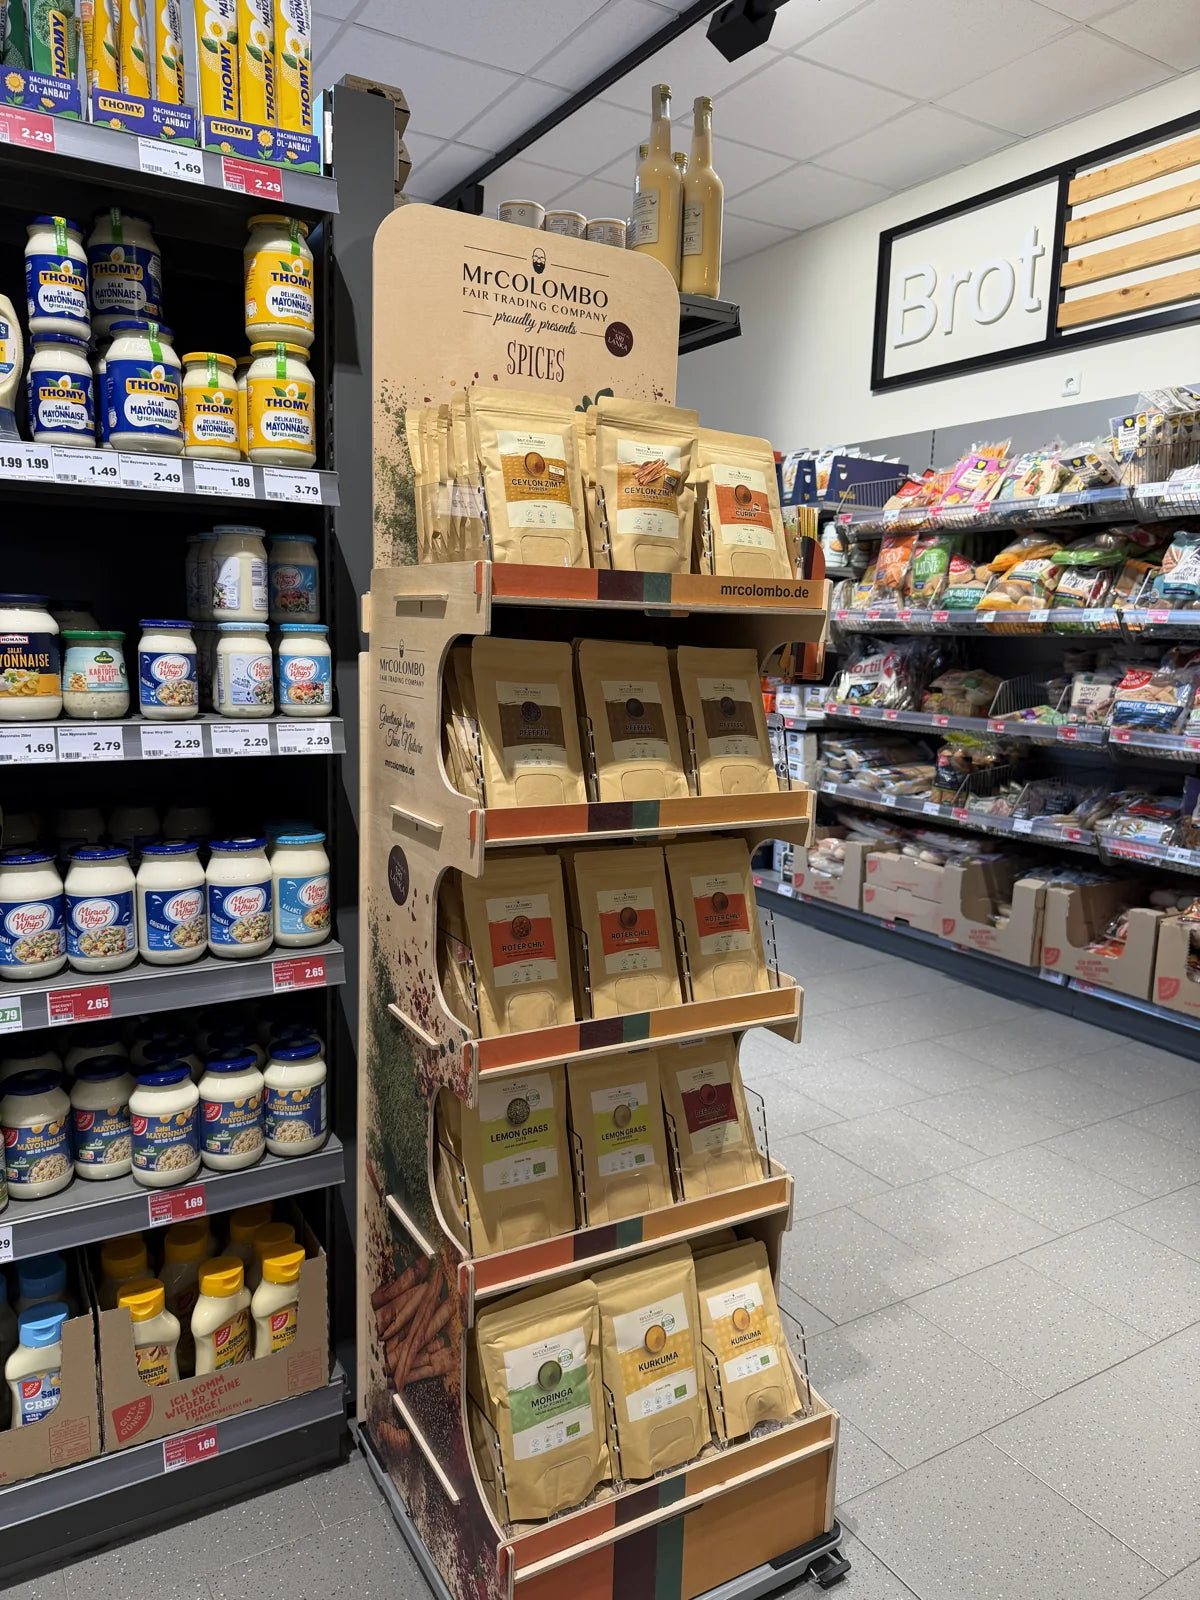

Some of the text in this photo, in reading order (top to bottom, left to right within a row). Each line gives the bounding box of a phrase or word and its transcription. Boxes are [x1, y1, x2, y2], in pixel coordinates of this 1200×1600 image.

[53, 14, 66, 77] HOMY
[29, 76, 71, 90] NACHHALTIGER
[176, 60, 184, 105] HOMY
[221, 43, 233, 112] THOMY
[264, 52, 275, 121] THOMY
[299, 59, 311, 127] THOMY
[101, 98, 142, 114] THOMY
[152, 107, 191, 120] NACHHALTIGER
[22, 127, 52, 142] 2.29
[213, 123, 251, 137] THOMY
[277, 132, 312, 144] NACHHALTIGER
[174, 161, 201, 174] 1.69
[255, 179, 281, 192] 2.29
[93, 263, 140, 276] THOMY
[41, 272, 84, 287] THOMY
[270, 272, 312, 289] THOMY
[463, 263, 608, 308] MrCOLOMBO
[893, 225, 1046, 349] Brot
[95, 289, 141, 300] MAYONNAISE
[43, 294, 85, 309] MAYONNAISE
[272, 296, 312, 313] MAYONNAISE
[463, 287, 608, 322] FAIR TRADING COMPANY
[493, 312, 577, 335] proudly presents
[507, 340, 565, 382] SPICES
[128, 380, 177, 394] THOMY
[40, 388, 84, 400] THOMY
[196, 404, 234, 414] THOMY
[265, 398, 309, 411] THOMY
[42, 409, 85, 421] MAYONNAISE
[130, 405, 178, 420] MAYONNAISE
[274, 416, 303, 424] DELIKATESS
[197, 424, 234, 435] MAYONNAISE
[266, 422, 310, 435] MAYONNAISE
[0, 457, 49, 469] 1.99 1.99
[89, 466, 117, 476] 1.49
[154, 472, 180, 482] 2.49
[231, 477, 250, 487] 1.89
[512, 478, 543, 486] CEYLON
[295, 485, 318, 495] 3.79
[625, 487, 656, 495] CEYLON
[720, 584, 809, 598] mrcolombo.de
[0, 653, 49, 667] YONNAISE
[158, 661, 186, 669] Miracel
[160, 668, 182, 680] Whip
[379, 658, 425, 677] MrCOLOMBO
[291, 670, 311, 680] Whip
[388, 676, 404, 685] TRADING
[405, 678, 424, 687] COMPANY
[402, 713, 415, 730] from
[93, 741, 121, 751] 2.79
[174, 739, 200, 748] 2.29
[243, 738, 268, 747] 2.29
[307, 736, 330, 745] 2.29
[25, 744, 54, 753] 1.69
[384, 759, 415, 776] mrcolombo.de
[172, 898, 200, 910] Miracel
[230, 894, 260, 903] Miracel
[78, 906, 110, 918] Miracel
[175, 906, 198, 920] Whip
[233, 902, 259, 915] Whip
[282, 903, 302, 915] BALANCE
[12, 911, 47, 923] Miracel
[80, 915, 107, 928] Whip
[15, 921, 44, 934] Whip
[149, 919, 170, 931] ORIGINAL
[612, 931, 633, 939] ROTER
[502, 943, 527, 951] ROTER
[305, 967, 323, 978] 2.65
[87, 998, 108, 1010] 2.65
[268, 1103, 310, 1112] MAYONNAISE
[220, 1108, 261, 1124] MAYONNAISE
[146, 1125, 192, 1139] MAYONNAISE
[491, 1124, 548, 1143] LEMON GRASS
[601, 1125, 647, 1141] LEMON GRASS
[17, 1133, 66, 1150] MAYONNAISE
[184, 1197, 203, 1209] 1.69
[730, 1330, 762, 1345] KURKUMA
[638, 1351, 679, 1372] KURKUMA
[139, 1368, 168, 1382] ONNAISE
[41, 1387, 60, 1399] Sala
[169, 1374, 225, 1408] ICH KOMM
[531, 1387, 573, 1408] MORINGA
[164, 1377, 241, 1420] WIEDER, KEINE
[185, 1398, 222, 1421] FRAGE!
[120, 1401, 146, 1436] GÜNSTIG
[197, 1438, 216, 1451] 1.69
